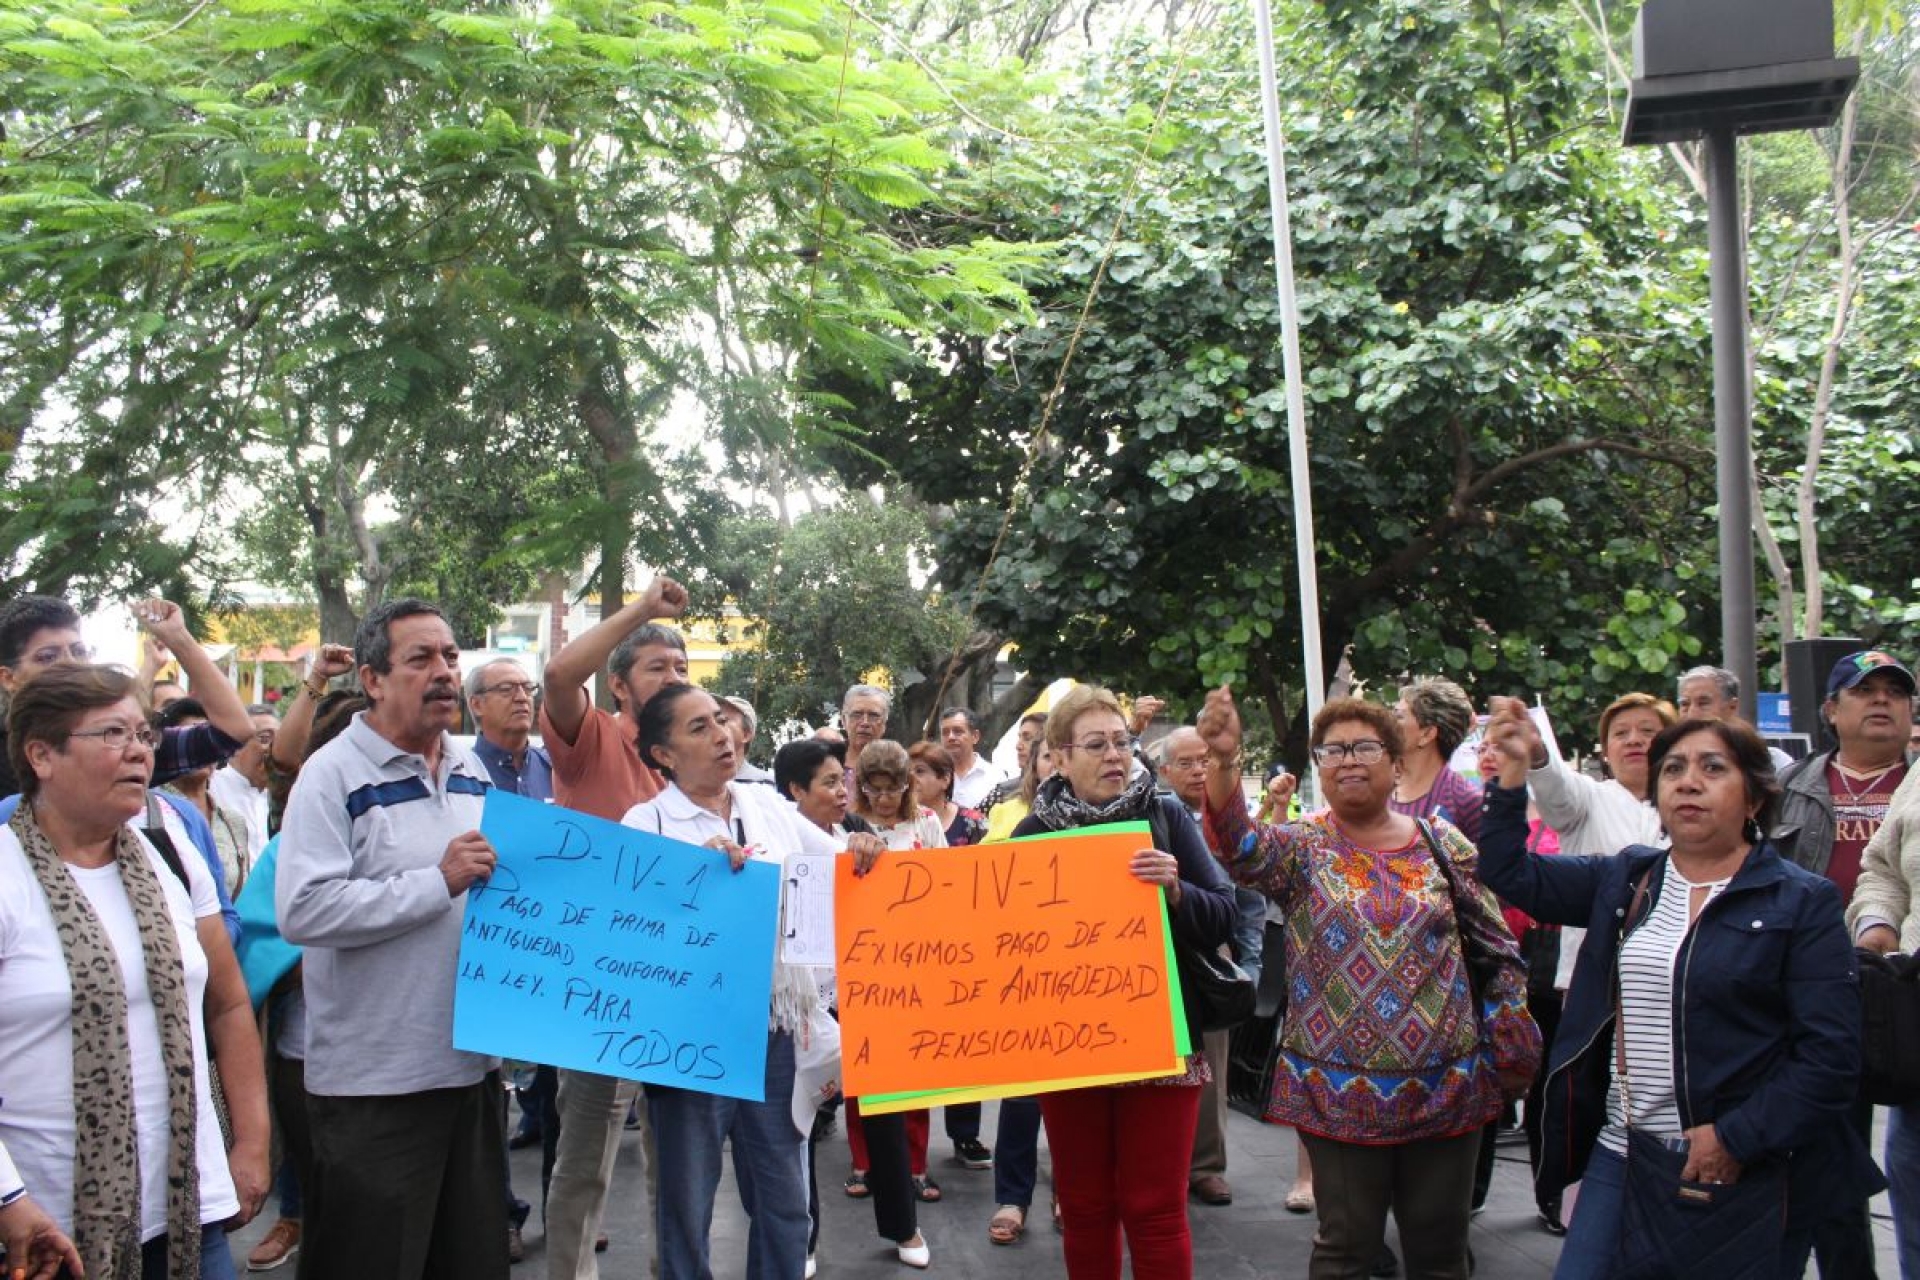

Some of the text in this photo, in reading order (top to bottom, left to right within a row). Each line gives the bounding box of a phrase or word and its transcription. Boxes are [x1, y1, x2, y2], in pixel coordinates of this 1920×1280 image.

[469, 863, 719, 948] PAGO DE PRIMA DE
[465, 915, 724, 992] ANTIGUEDAD CONFORME A
[843, 915, 1147, 968] EXIGIMOS PAGO DE LA
[461, 961, 632, 1022] LA LEY. PARA
[846, 963, 1159, 1009] PRIMA DE ANTIGÜEDAD
[593, 1029, 726, 1080] TODOS
[853, 1021, 1127, 1066] A PENSIONADOS.
